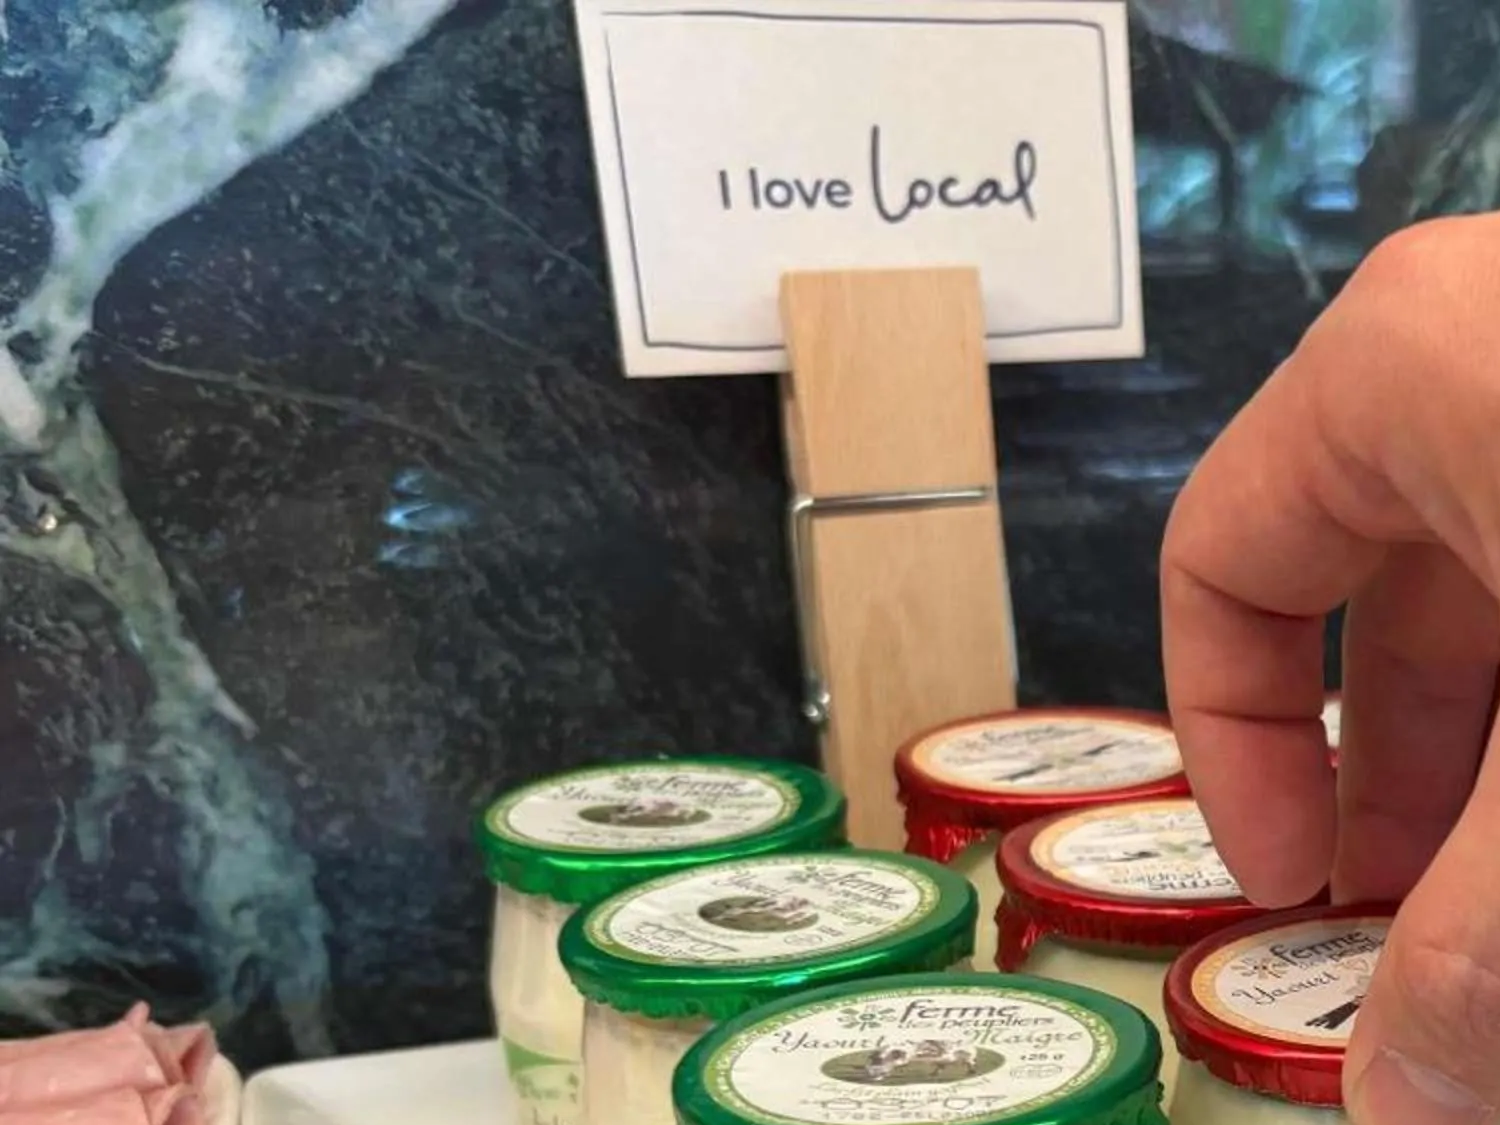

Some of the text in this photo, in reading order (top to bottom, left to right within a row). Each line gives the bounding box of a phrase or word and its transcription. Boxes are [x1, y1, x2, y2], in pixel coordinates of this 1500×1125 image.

[718, 170, 732, 210] I
[749, 168, 853, 209] love
[1268, 931, 1363, 967] ferme
[900, 998, 1021, 1023] ferme
[939, 1016, 1055, 1031] peupliers
[772, 1030, 887, 1054] Yaourt
[963, 1029, 1084, 1048] Maigre
